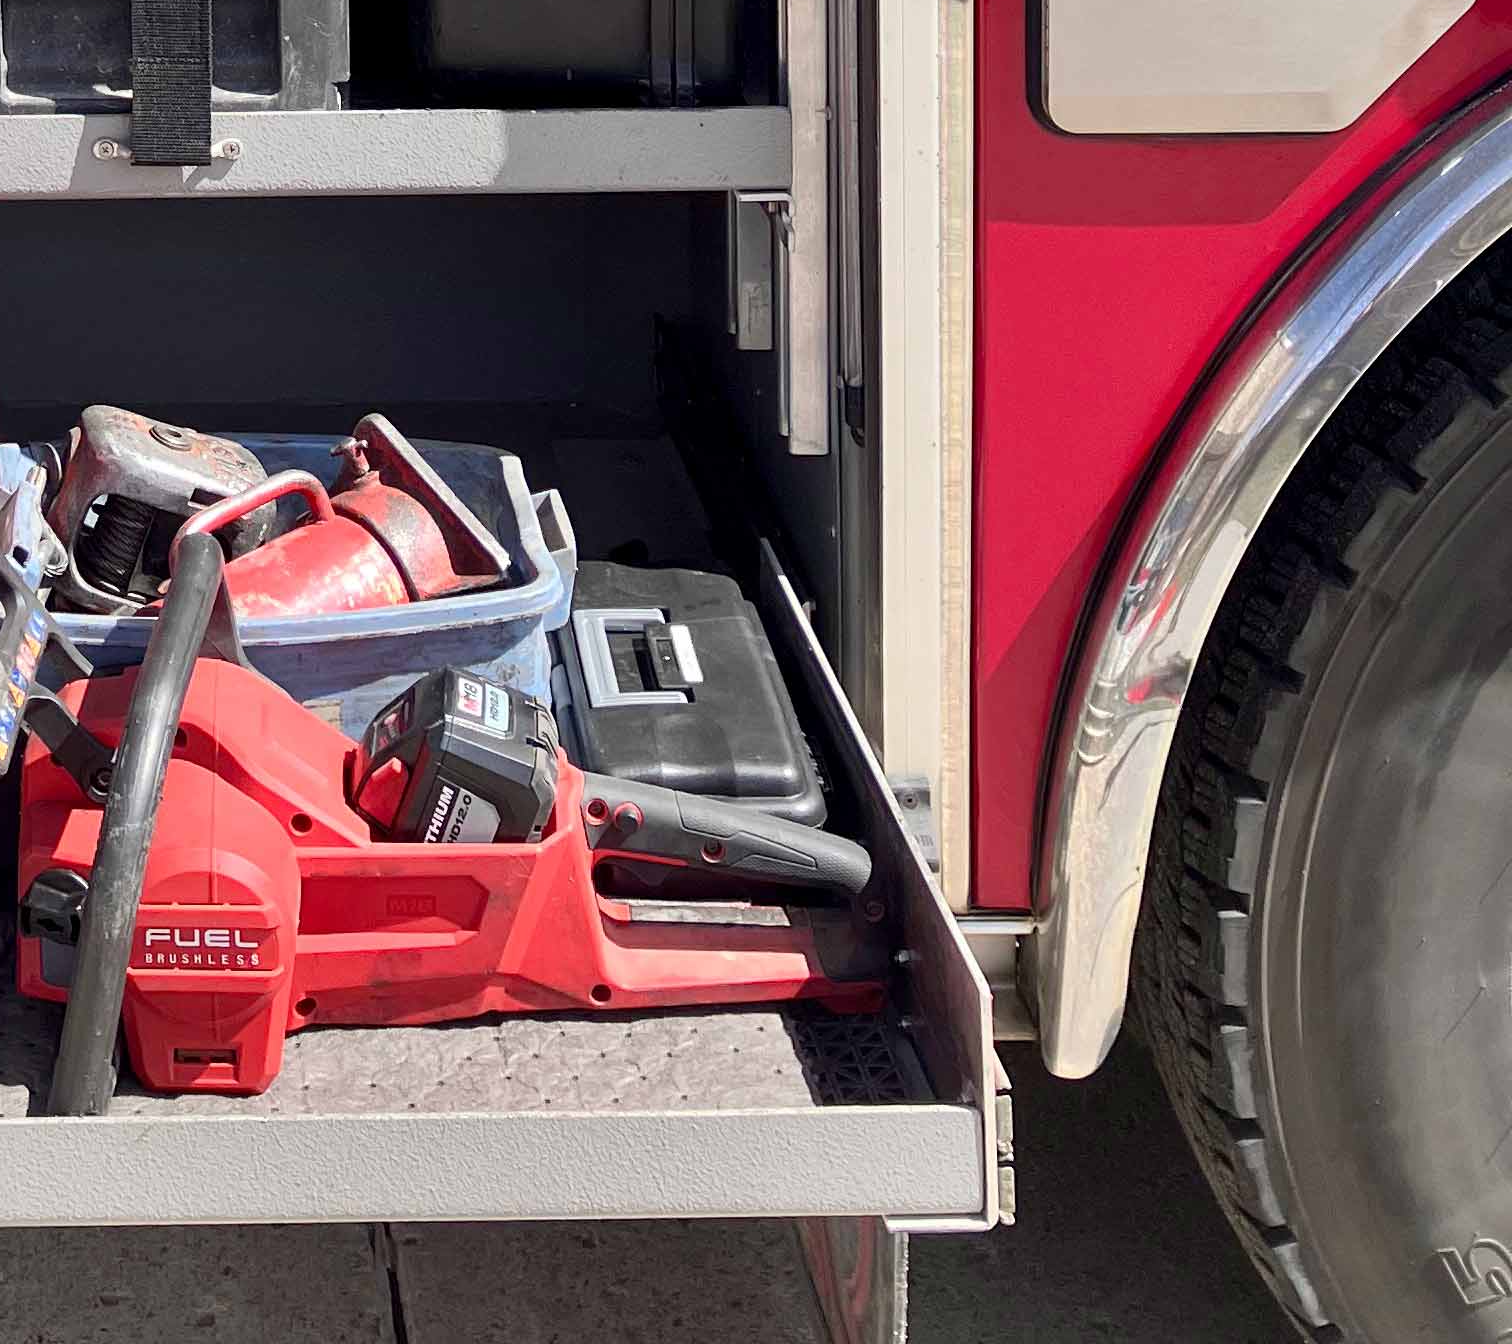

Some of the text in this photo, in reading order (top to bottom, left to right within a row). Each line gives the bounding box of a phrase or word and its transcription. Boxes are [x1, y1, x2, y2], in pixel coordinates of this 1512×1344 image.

[424, 785, 455, 843] THIUM
[145, 928, 260, 948] FUEL
[145, 953, 259, 965] BRUSHLESS
